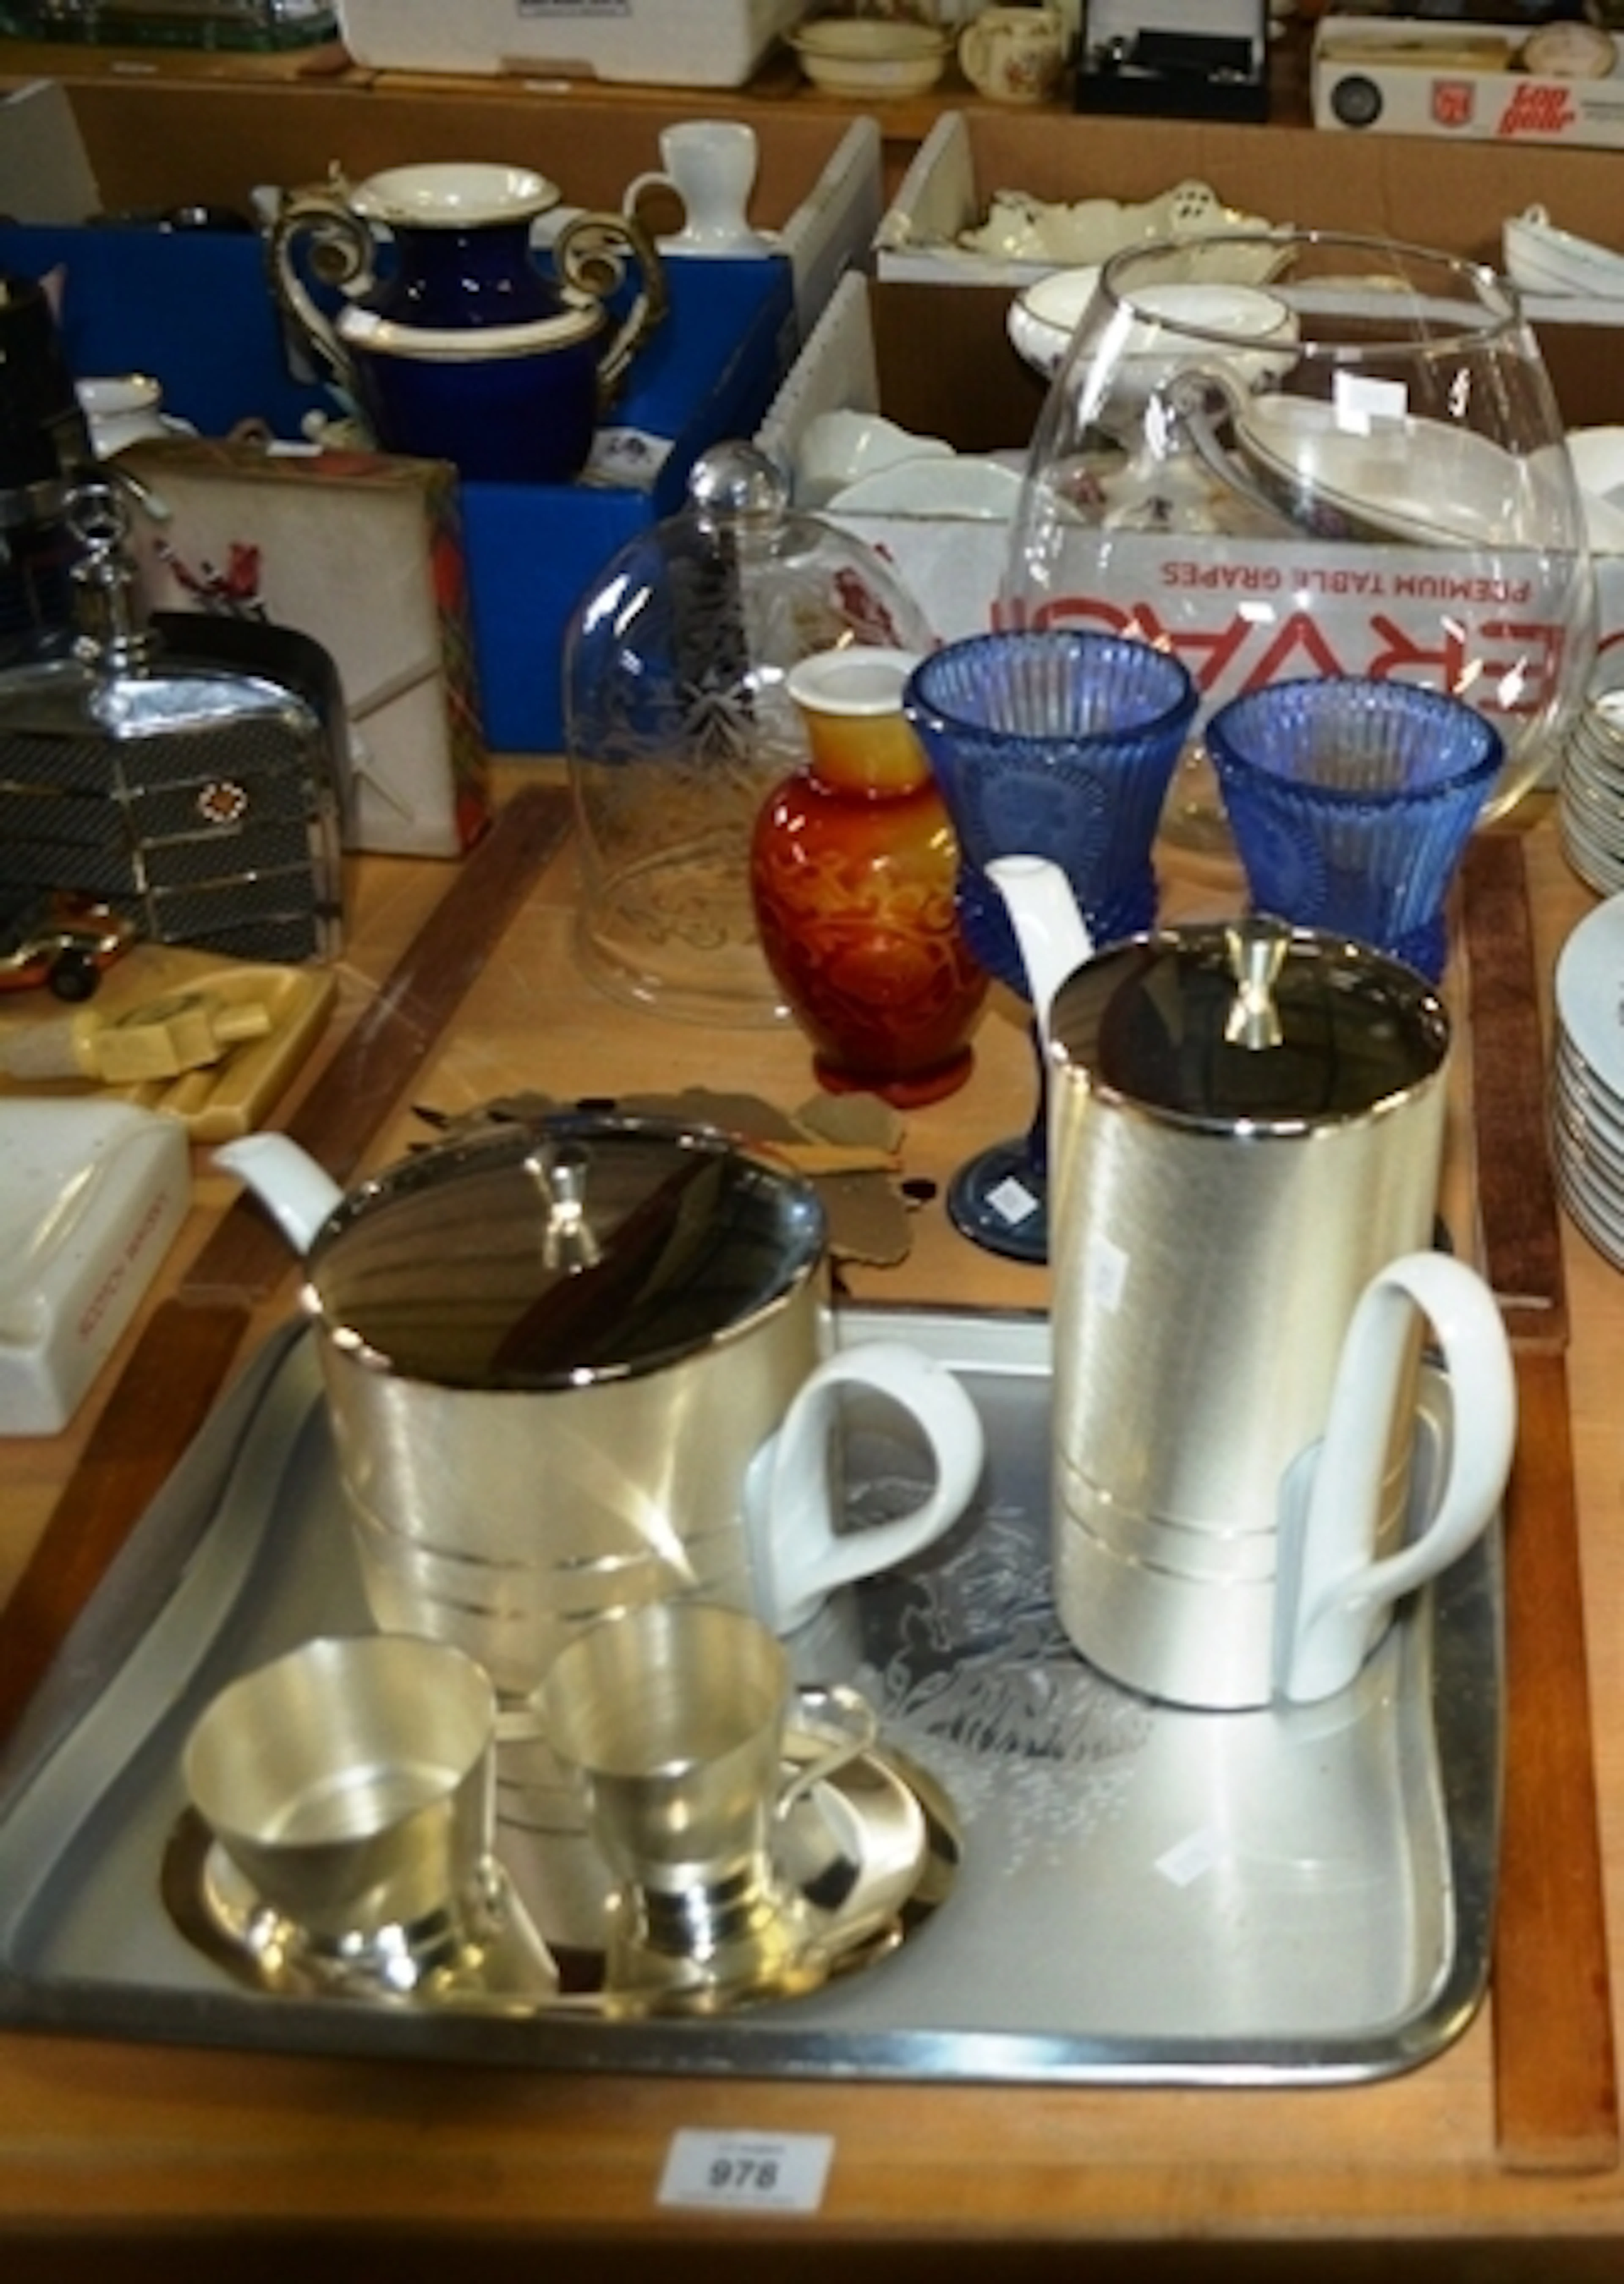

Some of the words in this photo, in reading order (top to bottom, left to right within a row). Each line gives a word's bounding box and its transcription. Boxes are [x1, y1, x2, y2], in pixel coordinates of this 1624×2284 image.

[1161, 562, 1280, 590] GRAPES
[1294, 569, 1383, 597] TABLE
[1396, 575, 1531, 603] PREMIUM
[709, 2158, 779, 2190] 978
